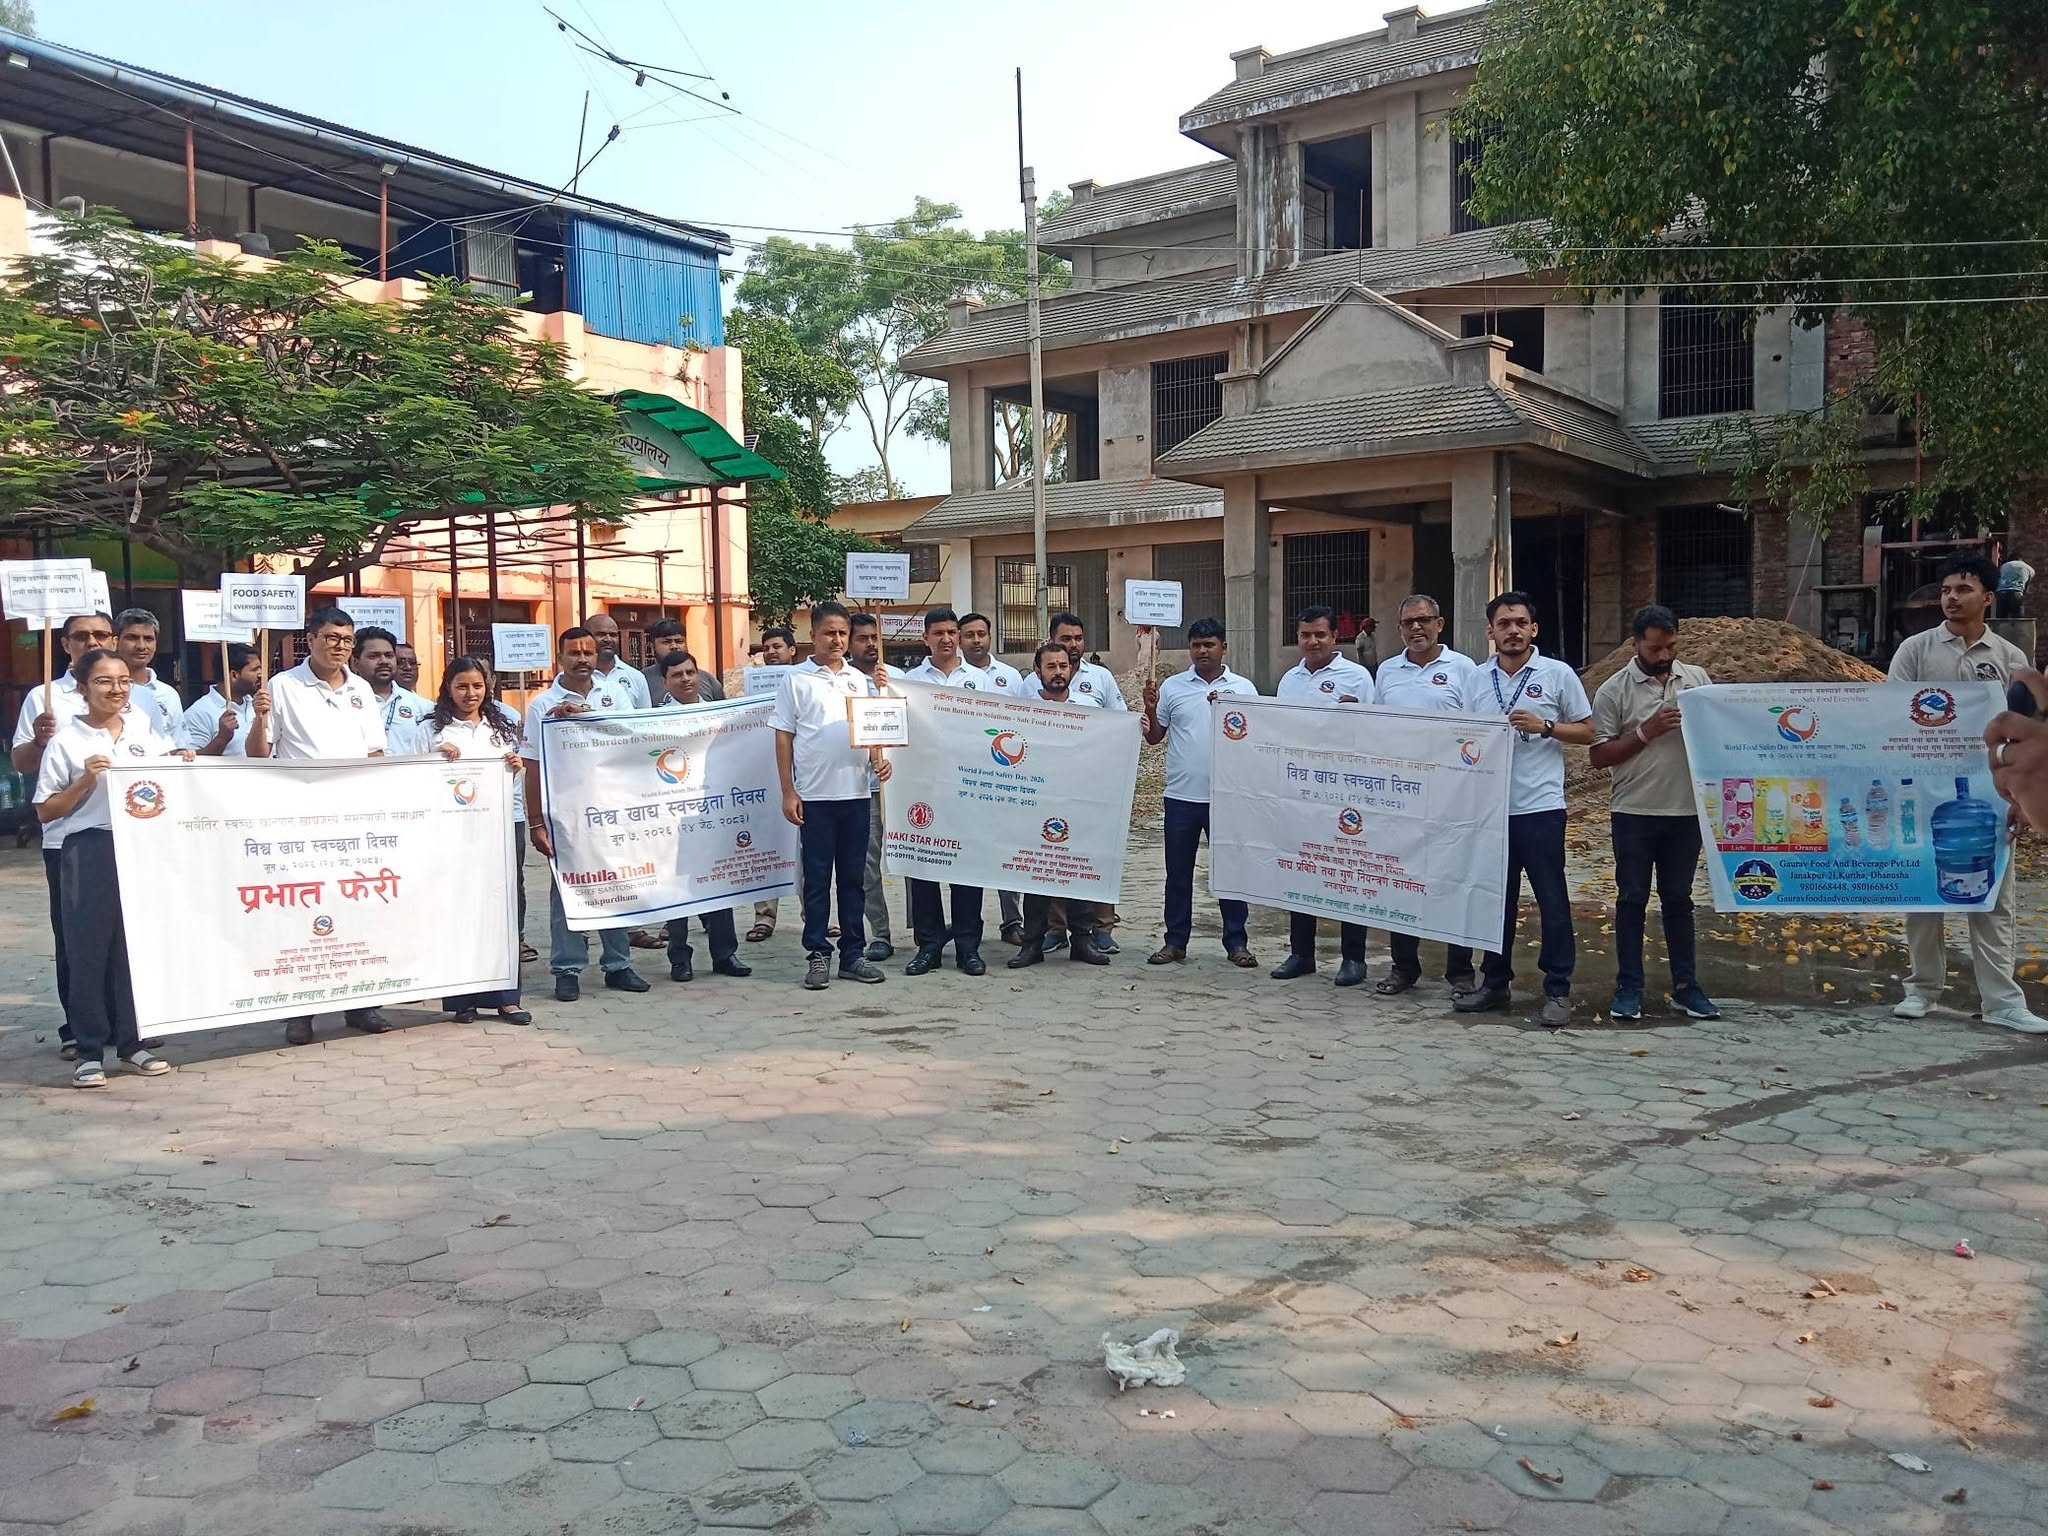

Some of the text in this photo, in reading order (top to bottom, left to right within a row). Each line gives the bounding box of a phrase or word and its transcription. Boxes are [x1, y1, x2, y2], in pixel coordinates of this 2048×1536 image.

[232, 589, 260, 598] FOOD
[952, 706, 975, 717] Burden
[983, 711, 1012, 721] Solutions
[1031, 718, 1047, 727] Food
[562, 740, 590, 750] From
[631, 735, 640, 744] to
[709, 724, 729, 736] Food
[1724, 743, 1742, 751] World
[1743, 743, 1758, 751] Food
[958, 765, 978, 774] World
[996, 771, 1013, 780] Safety
[1030, 775, 1045, 783] 2026
[1286, 762, 1422, 796] विश्व खाद्य स्वच्छता दिवस
[584, 786, 767, 828] विश्व खाद्य स्वच्छता दिवस
[244, 831, 399, 857] विश्व खाद्य स्वच्छता दिवस
[610, 834, 626, 846] जून
[910, 834, 932, 847] STAR
[933, 837, 962, 850] HOTEL
[1794, 843, 1823, 852] Orange
[1277, 858, 1293, 870] खाद्य
[1320, 865, 1337, 878] तथा
[1339, 869, 1354, 884] गुण
[1358, 868, 1390, 887] नियन्त्रण
[1780, 859, 1889, 870] Gaurav Food And Beverage
[562, 869, 618, 885] Mithila
[1790, 870, 1909, 880] Janakpur Dhanusha
[237, 867, 402, 914] प्रभात फेरी
[575, 888, 597, 897] CHEF
[1851, 882, 1899, 891] 9801668455
